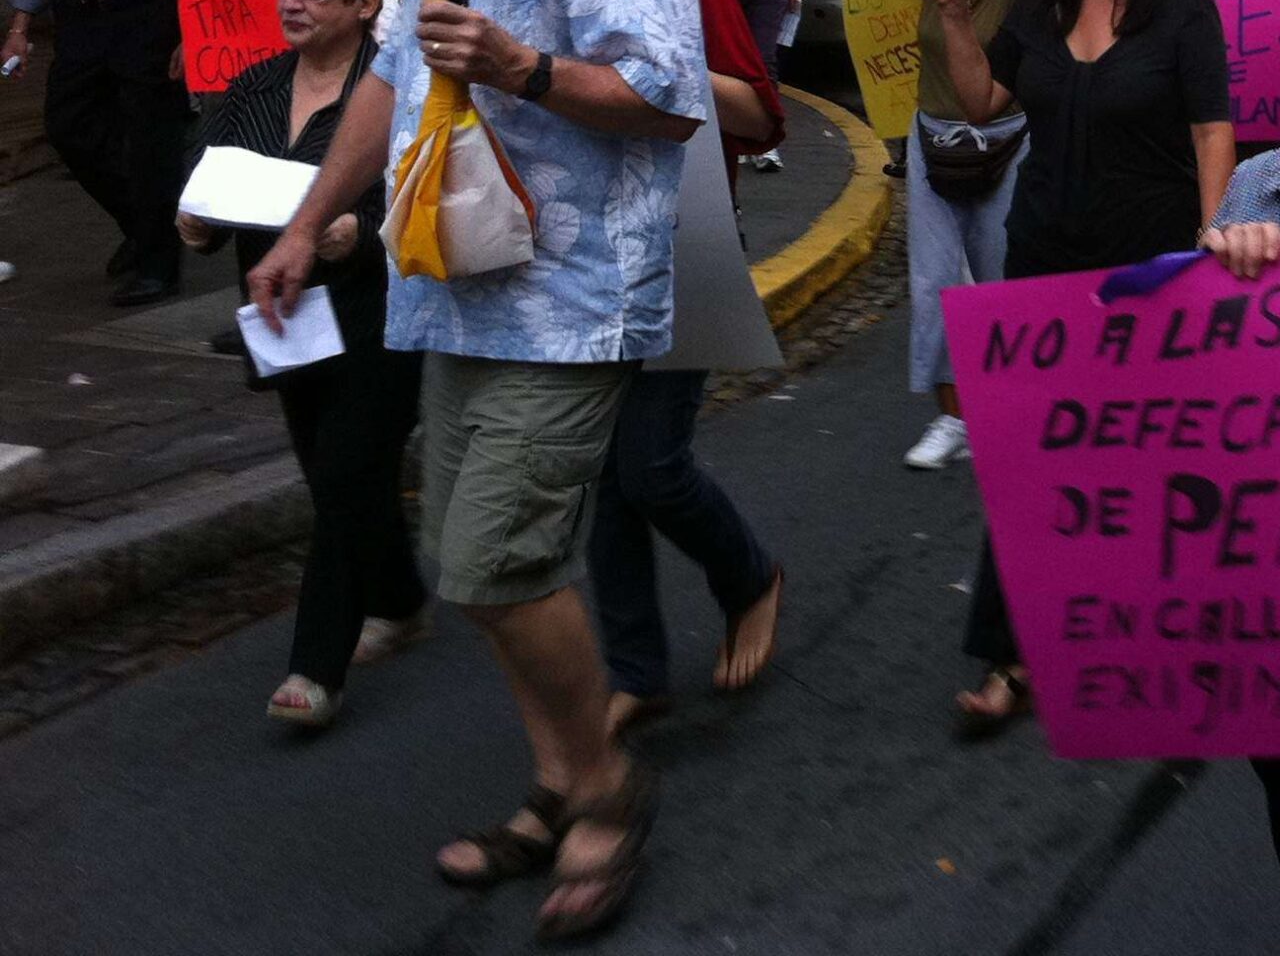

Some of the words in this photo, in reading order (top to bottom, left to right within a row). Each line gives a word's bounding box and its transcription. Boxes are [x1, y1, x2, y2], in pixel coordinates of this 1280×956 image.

[983, 317, 1067, 373] NO
[1097, 312, 1137, 367] A
[1051, 486, 1134, 539] DE
[1063, 595, 1137, 644] EN
